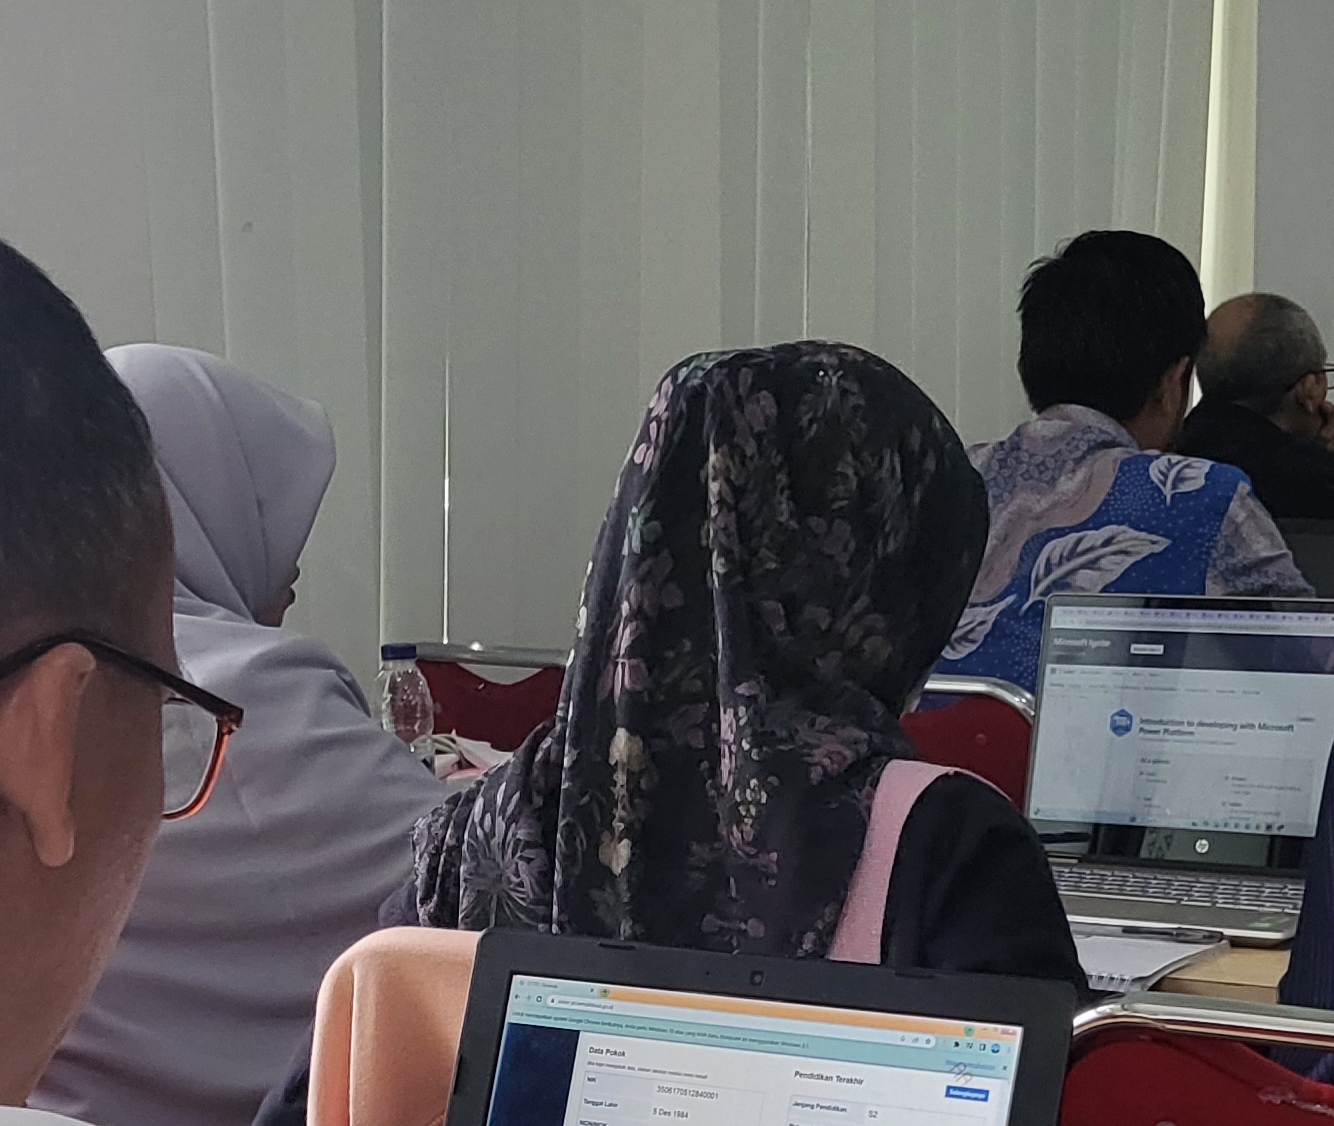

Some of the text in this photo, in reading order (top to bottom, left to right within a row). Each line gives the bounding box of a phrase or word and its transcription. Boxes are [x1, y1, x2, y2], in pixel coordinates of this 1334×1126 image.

[1140, 718, 1295, 733] Introduction to developing with Microsoft
[1139, 727, 1195, 737] Power Platform
[588, 1046, 626, 1058] Data Pokok
[794, 1070, 864, 1086] Pendidikan Terakhir
[583, 1099, 603, 1107] Tanggal
[792, 1101, 847, 1113] Jenjang Pendidikan
[652, 1107, 689, 1119] 5 Des 1984
[868, 1110, 878, 1119] S2
